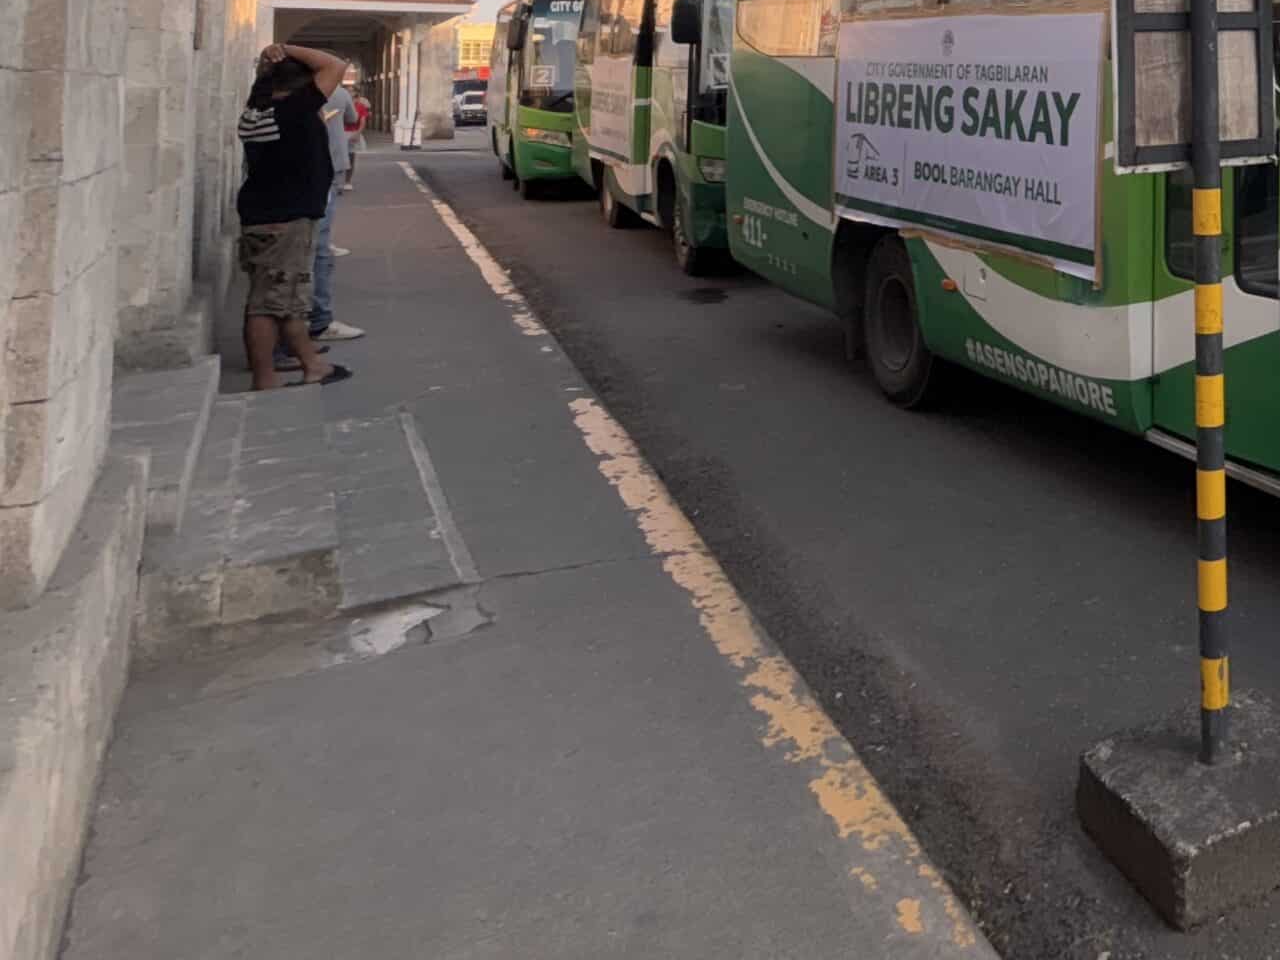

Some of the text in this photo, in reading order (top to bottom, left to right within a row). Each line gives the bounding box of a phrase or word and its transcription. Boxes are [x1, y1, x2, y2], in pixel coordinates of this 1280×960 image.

[550, 1, 571, 13] CITY
[535, 69, 549, 83] 2
[866, 62, 1048, 83] CITY GOVERNMENT OF TAGBILARAN
[846, 81, 1080, 147] LIBRENG SAKAY
[864, 165, 899, 187] AREA 3
[913, 160, 1062, 206] BOOL BARANGAY HALL
[965, 337, 1117, 417] #ASENSOPAMORE
